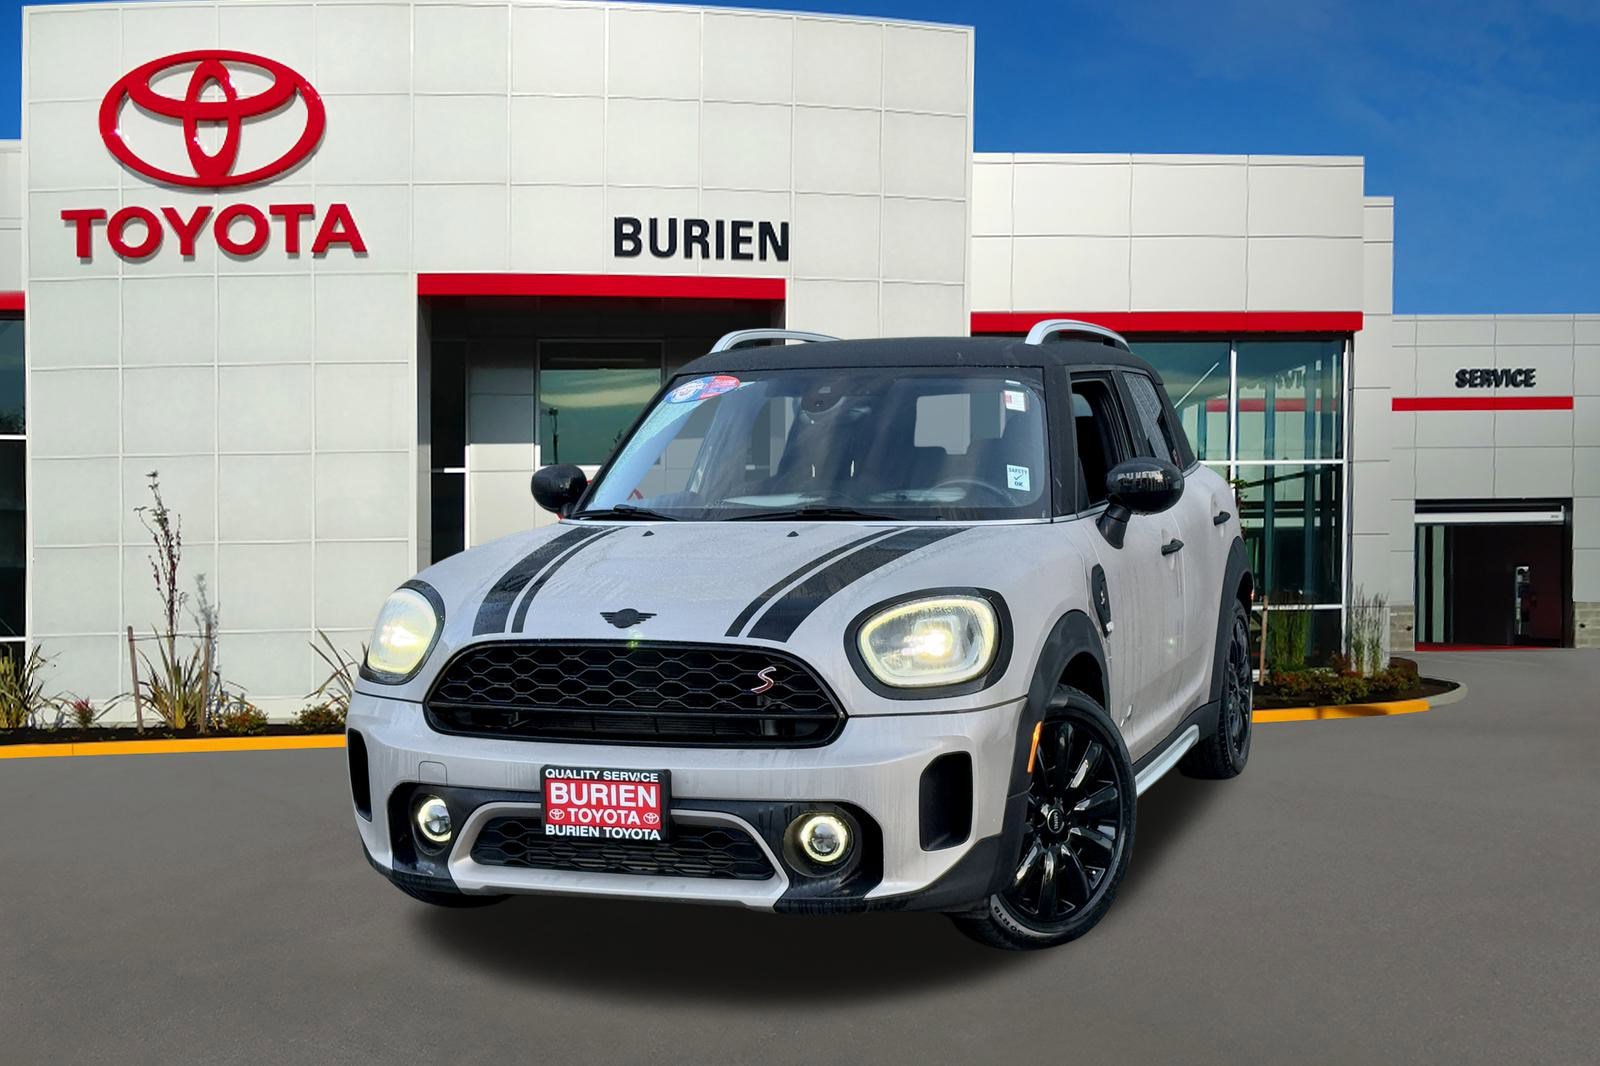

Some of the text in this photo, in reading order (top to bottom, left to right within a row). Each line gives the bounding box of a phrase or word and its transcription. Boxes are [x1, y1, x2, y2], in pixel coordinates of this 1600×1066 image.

[61, 204, 368, 262] TOYOTA
[614, 217, 789, 261] BURIEN
[1455, 368, 1536, 388] SERVICE
[750, 665, 777, 694] S
[545, 768, 659, 782] QUALITY SERVICE
[550, 782, 657, 808] BURIEN
[567, 807, 641, 826] TOYOTA
[545, 823, 661, 841] BURIEN TOYOTA
